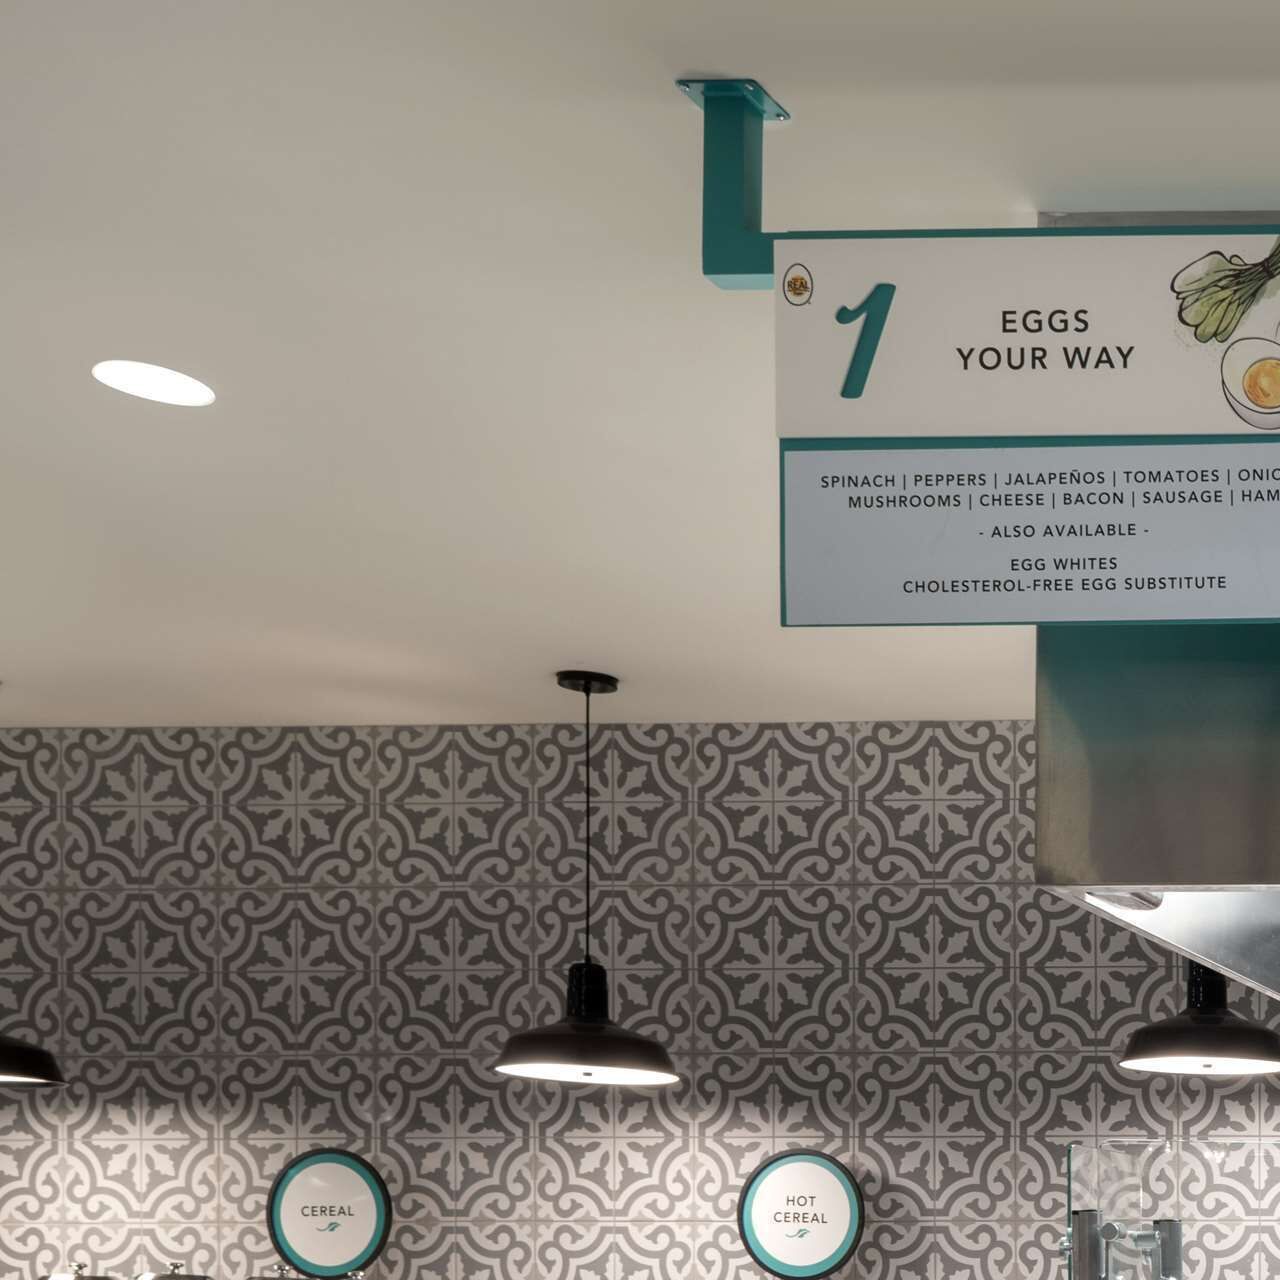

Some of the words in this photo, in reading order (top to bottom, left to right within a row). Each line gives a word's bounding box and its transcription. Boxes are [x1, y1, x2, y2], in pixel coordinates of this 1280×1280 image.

[1001, 308, 1089, 334] EGGS
[835, 282, 897, 399] 1
[955, 346, 1048, 371] YOUR
[1062, 345, 1135, 370] WAY
[820, 474, 896, 489] SPINACH
[913, 473, 987, 487] PEPPERS
[1004, 469, 1105, 486] JALAPEÑOS
[1122, 468, 1220, 484] TOMATOES
[848, 494, 961, 509] MUSHROOMS
[979, 493, 1045, 507] CHEESE
[1063, 491, 1124, 506] BACON
[1142, 489, 1223, 505] SAUSAGE
[1241, 488, 1280, 503] HAM
[990, 524, 1036, 539] ALSO
[1042, 523, 1137, 537] AVAILABLE
[1010, 558, 1046, 572] EGG
[1052, 556, 1118, 571] WHITES
[902, 578, 1074, 594] CHOLESTEROL-FREE
[1081, 577, 1117, 591] EGG
[1124, 575, 1227, 591] SUBSTITUTE
[786, 1195, 817, 1207] HOT
[300, 1205, 355, 1217] CEREAL
[773, 1211, 829, 1224] CEREAL
